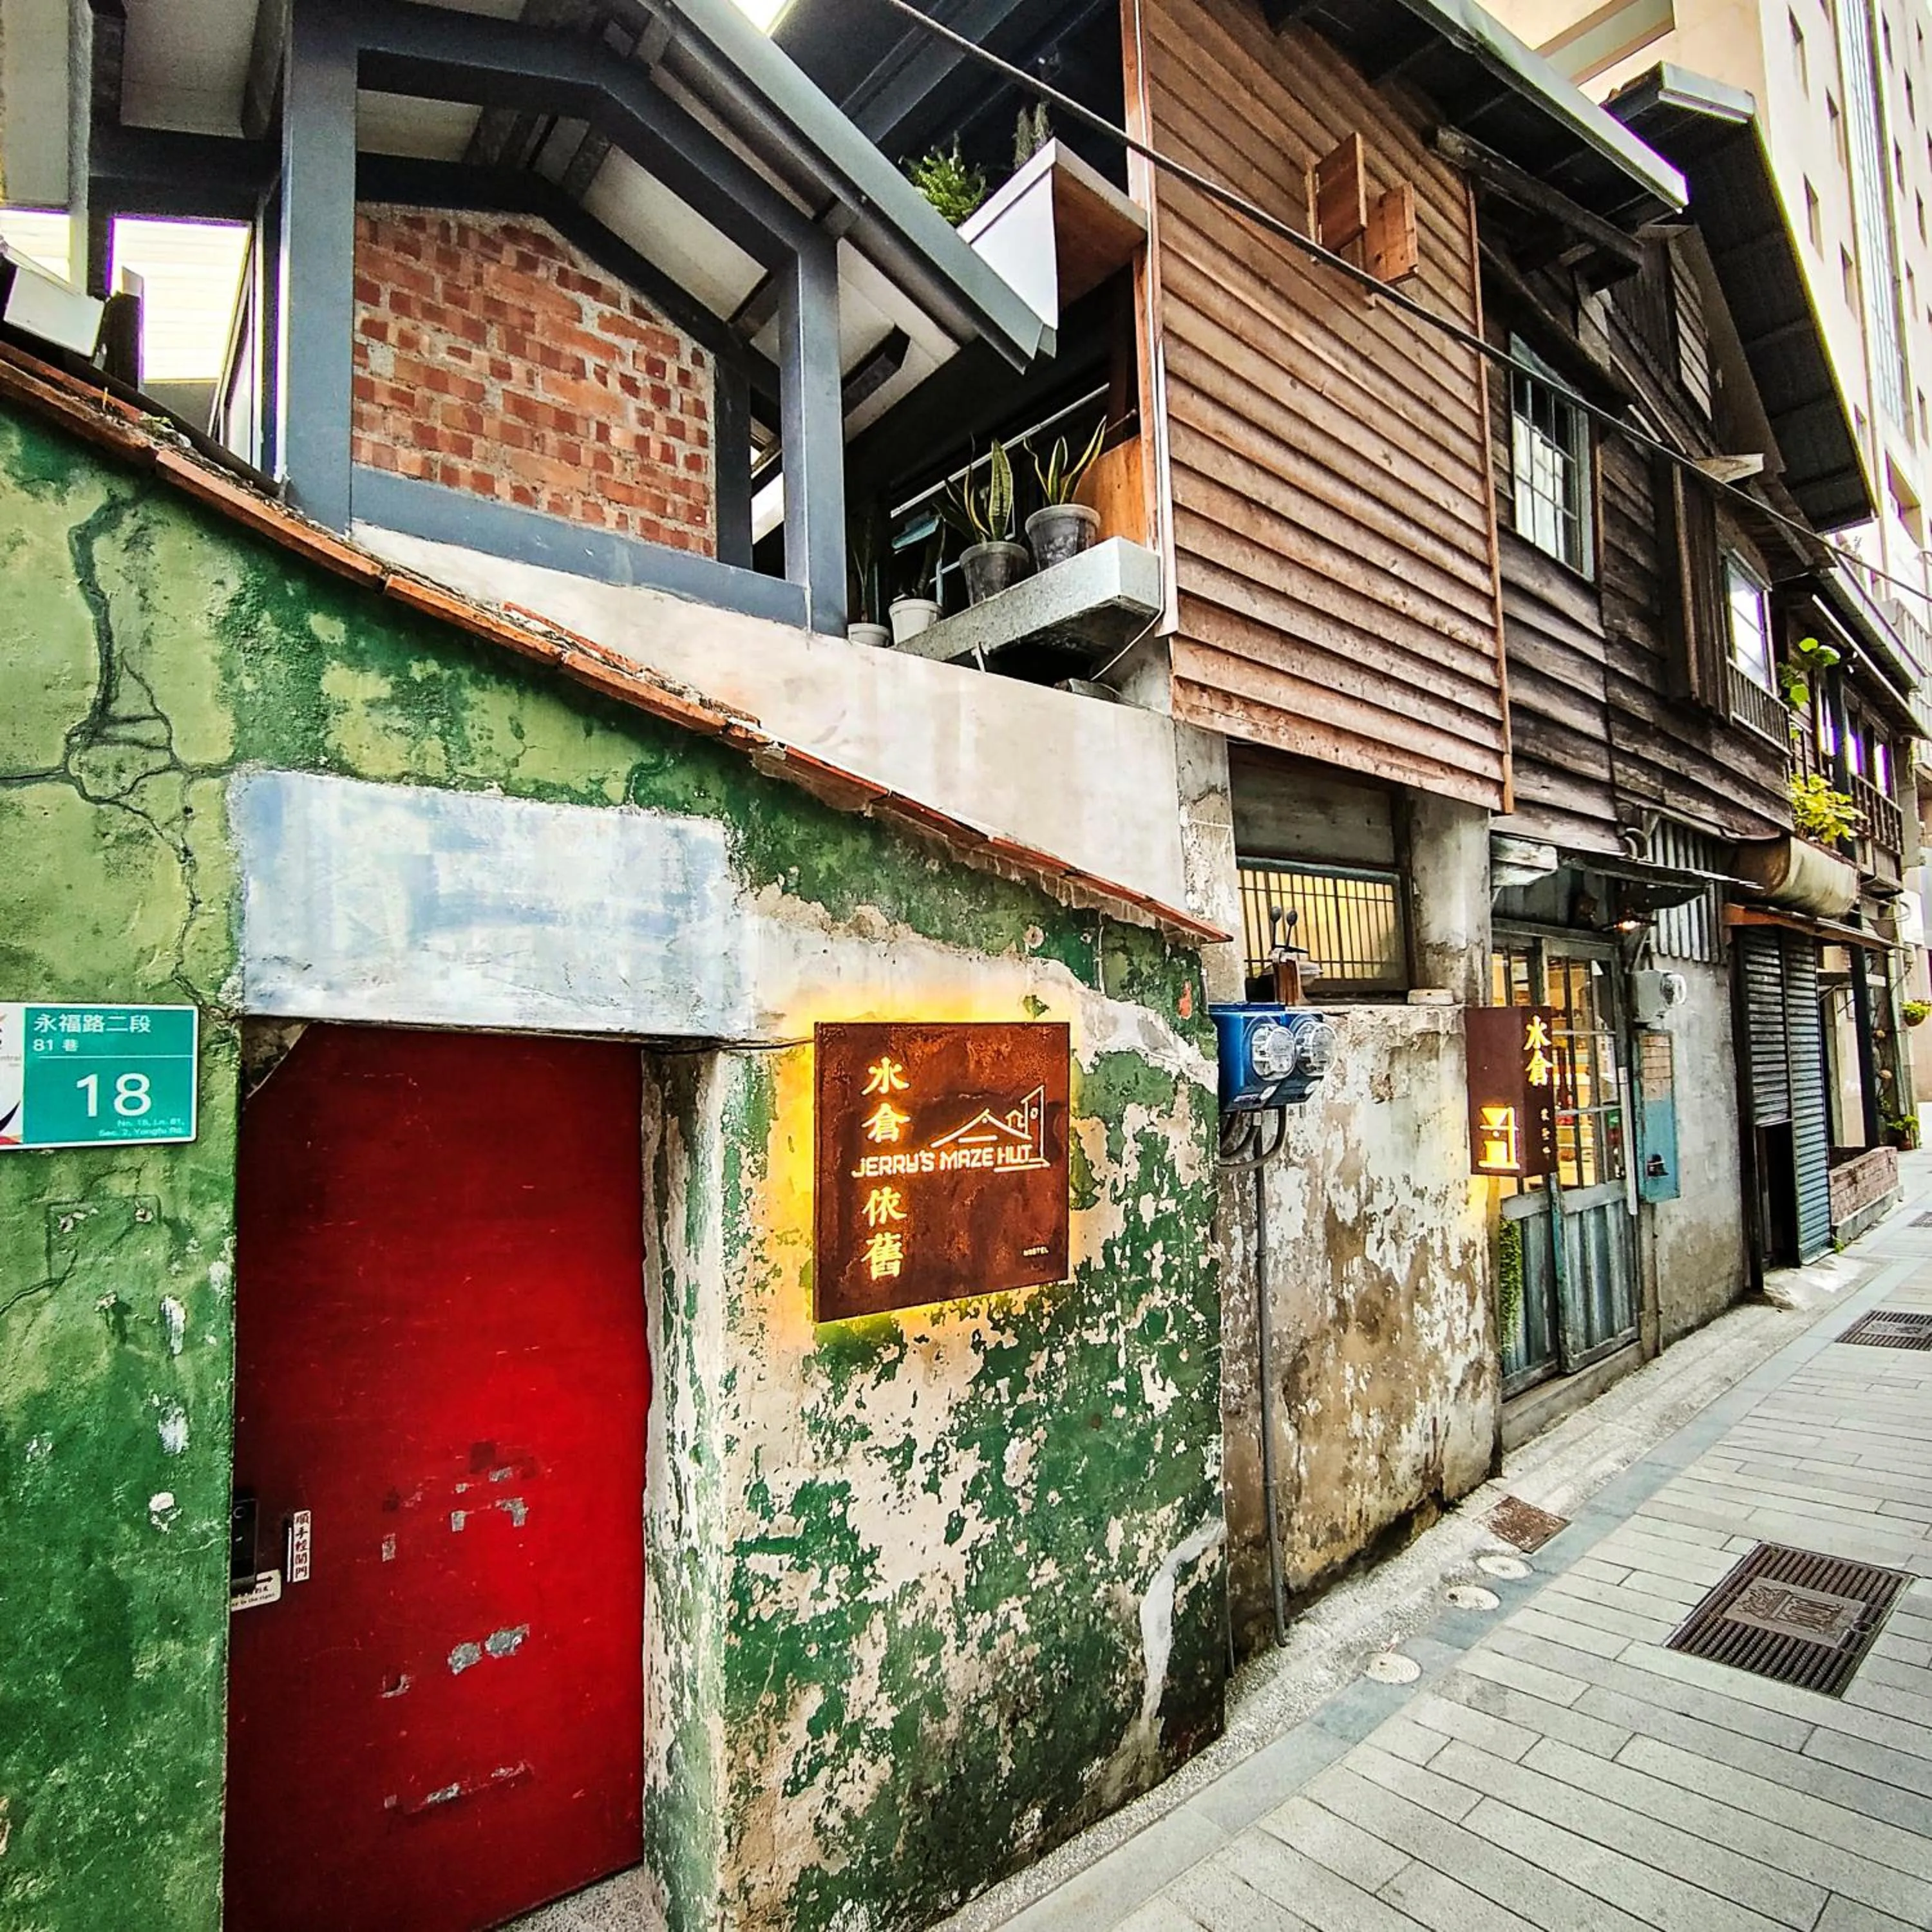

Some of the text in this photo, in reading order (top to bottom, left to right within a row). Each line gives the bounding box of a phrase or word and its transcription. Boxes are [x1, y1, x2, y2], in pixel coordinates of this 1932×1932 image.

[33, 1014, 151, 1033] 永福路二段
[33, 1039, 79, 1052] 81 巷
[1524, 1015, 1553, 1086] 水倉
[76, 1072, 152, 1117] 18
[851, 1144, 1033, 1178] JERRY'S MAZE HUT
